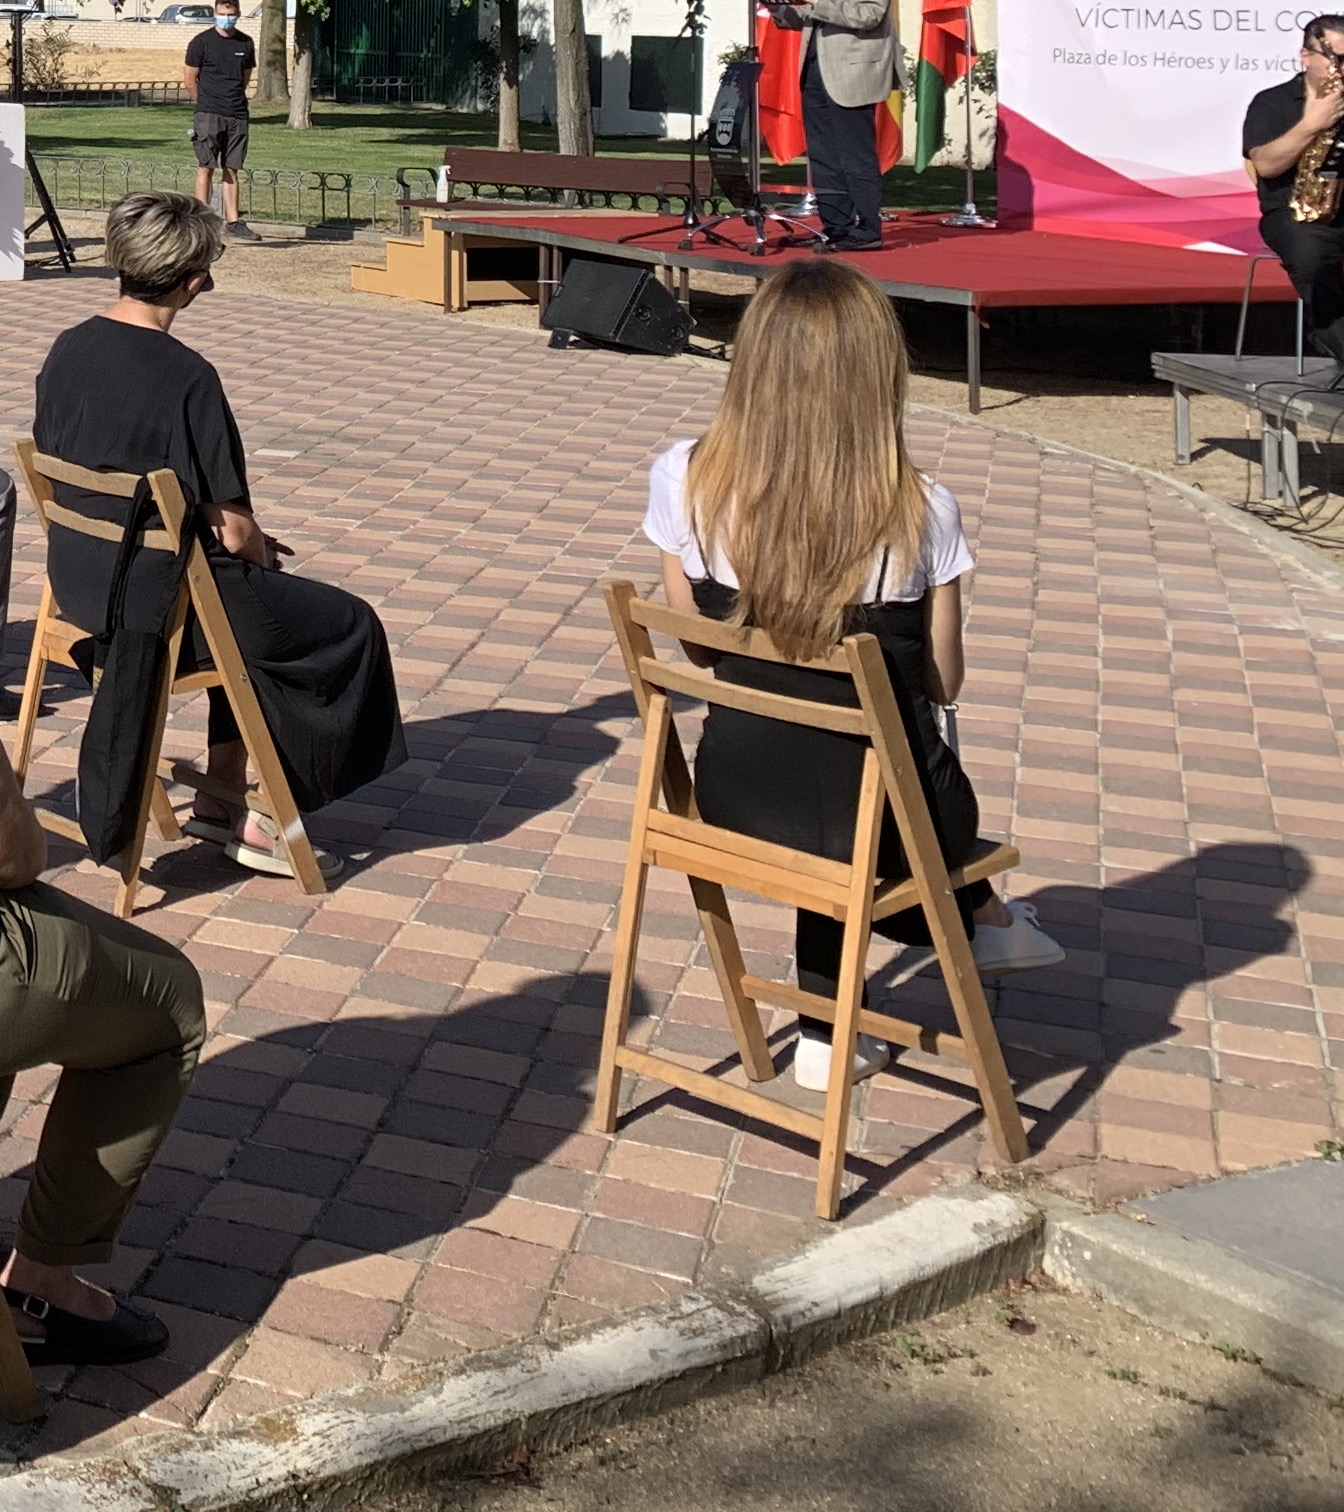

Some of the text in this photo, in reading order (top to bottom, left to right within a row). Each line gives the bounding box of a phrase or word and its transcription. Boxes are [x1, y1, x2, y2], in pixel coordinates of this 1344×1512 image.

[1075, 1, 1202, 30] VÍCTIMAS
[1213, 9, 1267, 32] DEL
[1052, 47, 1092, 65] Plaza
[1095, 49, 1118, 66] de
[1123, 49, 1147, 67] los
[1153, 51, 1214, 69] Héroes
[1219, 57, 1230, 74] y
[1235, 52, 1259, 71] las
